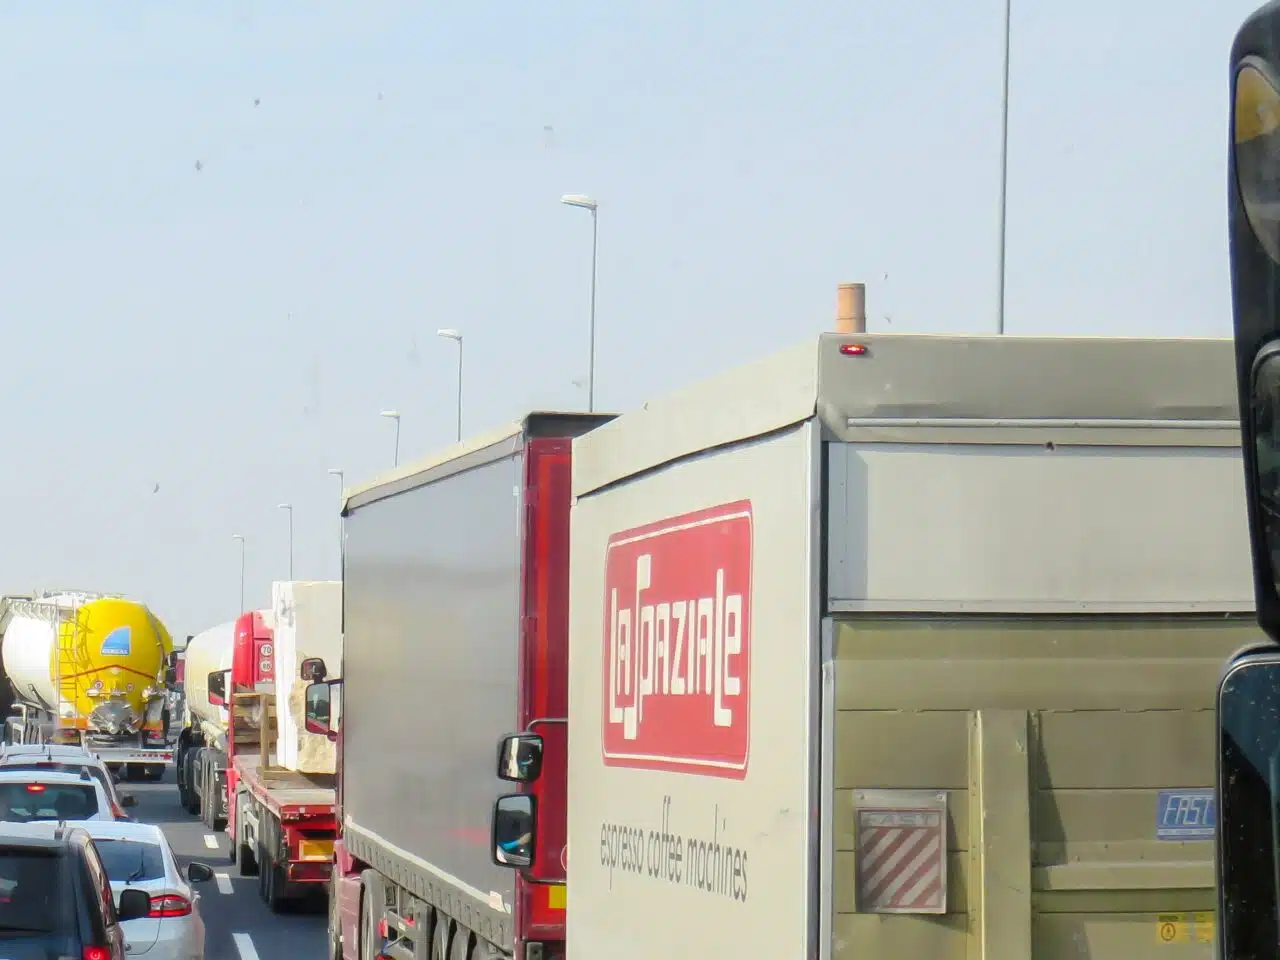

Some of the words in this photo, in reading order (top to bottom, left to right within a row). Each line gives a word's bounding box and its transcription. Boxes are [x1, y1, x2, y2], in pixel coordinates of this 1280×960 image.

[1163, 794, 1214, 826] FAST
[600, 823, 645, 891] espresso
[647, 795, 683, 884] coffee
[686, 804, 748, 903] machines
